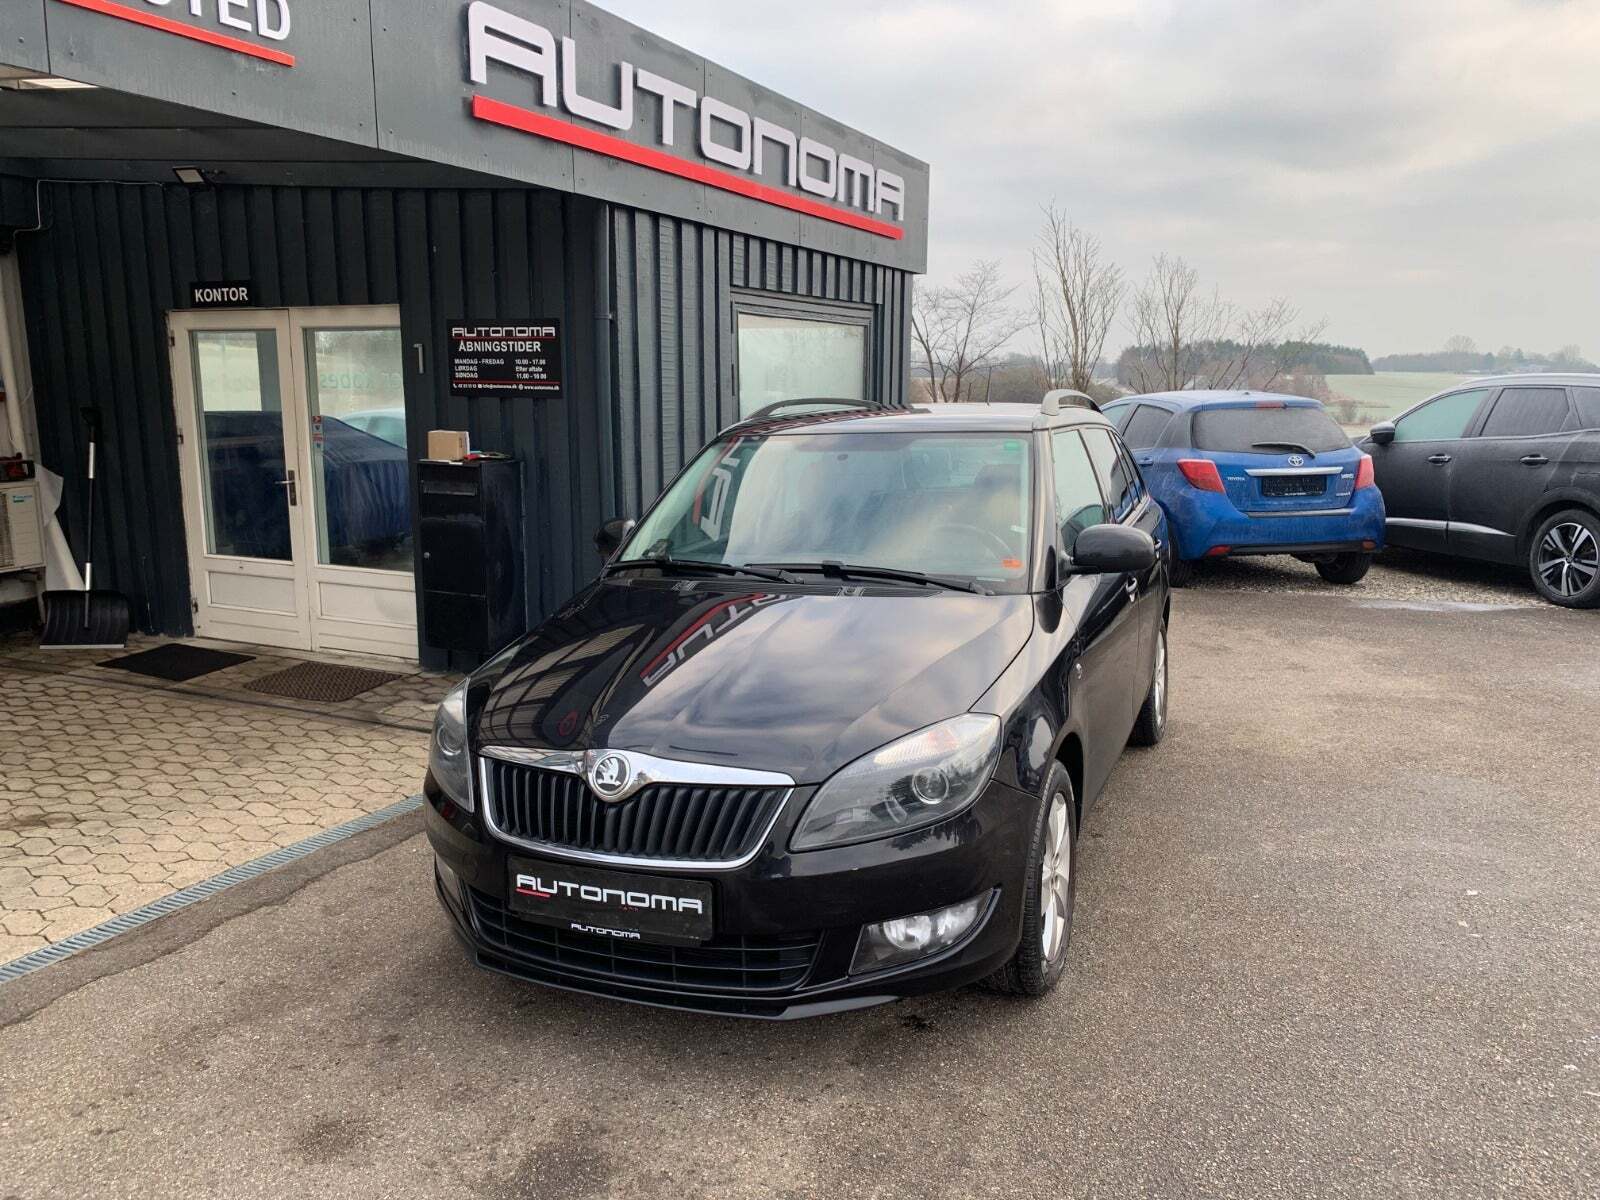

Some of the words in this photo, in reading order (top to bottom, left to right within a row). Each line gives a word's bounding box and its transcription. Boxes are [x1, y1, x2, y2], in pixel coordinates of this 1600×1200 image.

[468, 0, 906, 221] AUTONOMA
[194, 287, 249, 303] KONTOR
[452, 327, 556, 337] AUTONOMA
[458, 340, 541, 352] ÅBNINGSTIDER
[482, 358, 505, 366] FREDAG
[516, 873, 704, 915] AUTONOMA
[570, 922, 642, 940] AUTONOMA
